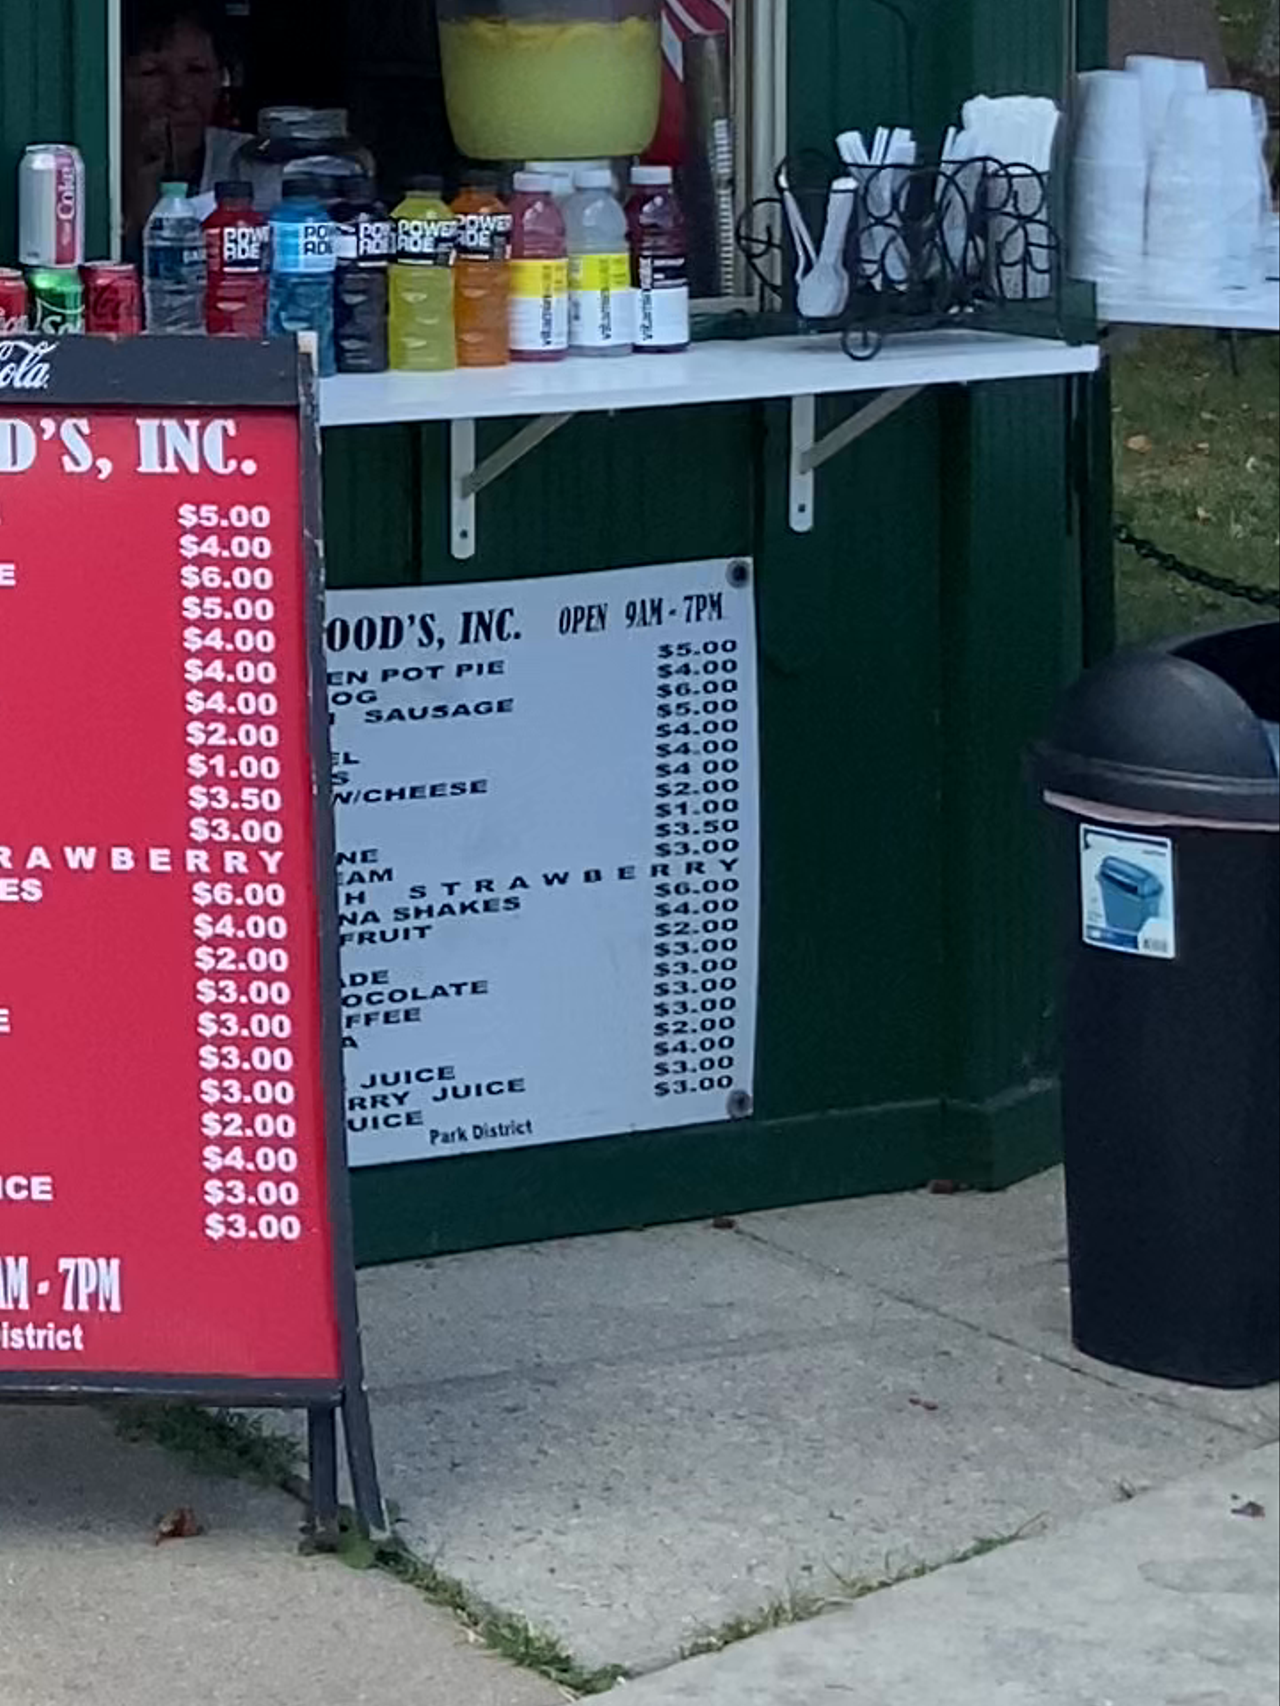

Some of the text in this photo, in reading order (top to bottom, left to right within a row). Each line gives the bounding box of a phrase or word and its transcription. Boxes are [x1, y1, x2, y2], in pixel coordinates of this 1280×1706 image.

[135, 417, 257, 475] INC.
[177, 503, 271, 529] $5.00
[179, 533, 272, 559] $4.00
[180, 564, 273, 590] $6.00
[182, 595, 274, 621] $5.00
[327, 591, 724, 653] OOD'S, INC. OPEN 9AM 7PM
[183, 626, 275, 653] $4.00
[184, 658, 277, 684] $4.00
[381, 664, 445, 683] POT
[455, 660, 504, 678] PIE
[658, 639, 737, 660] $5.00
[331, 658, 738, 706] OG $4.00
[185, 689, 278, 716] $4.00
[364, 679, 738, 724] SAUSAGE $6.00
[656, 698, 738, 719] $5.00
[186, 720, 279, 748] $2.00
[656, 718, 739, 738] $4.00
[655, 738, 739, 759] $4.00
[187, 752, 280, 780] $1.00
[188, 784, 281, 811] $3.50
[655, 778, 739, 798] $2.00
[655, 798, 739, 818] $1.00
[189, 816, 283, 844] $3.00
[655, 819, 739, 838] $3.50
[655, 838, 740, 858] $3.00
[409, 857, 739, 900] STRAWBERRY
[192, 880, 285, 907] $6.00
[393, 896, 521, 922] SHAKES
[654, 878, 740, 898] $6.00
[193, 912, 287, 941] $4.00
[340, 898, 739, 947] FRUIT $4.00
[654, 917, 739, 937] $2.00
[195, 945, 289, 972] $2.00
[653, 937, 738, 958] $3.00
[196, 978, 291, 1005] $3.00
[342, 957, 738, 1008] OCOLATE $3.00
[345, 976, 737, 1029] FFEE $3.00
[653, 996, 737, 1018] $3.00
[197, 1011, 291, 1039] $3.00
[653, 1015, 736, 1037] $2.00
[199, 1044, 293, 1072] $3.00
[360, 1035, 735, 1090] JUICE $4.00
[200, 1077, 295, 1105] $3.00
[432, 1077, 526, 1102] JUICE
[654, 1055, 734, 1077] $3.00
[347, 1074, 734, 1133] UICE $3.00
[201, 1110, 296, 1139] $2.00
[429, 1119, 532, 1145] Park District
[202, 1145, 298, 1172] $4.00
[204, 1179, 299, 1207] $3.00
[205, 1212, 301, 1241] $3.00
[58, 1257, 122, 1313] 7PM
